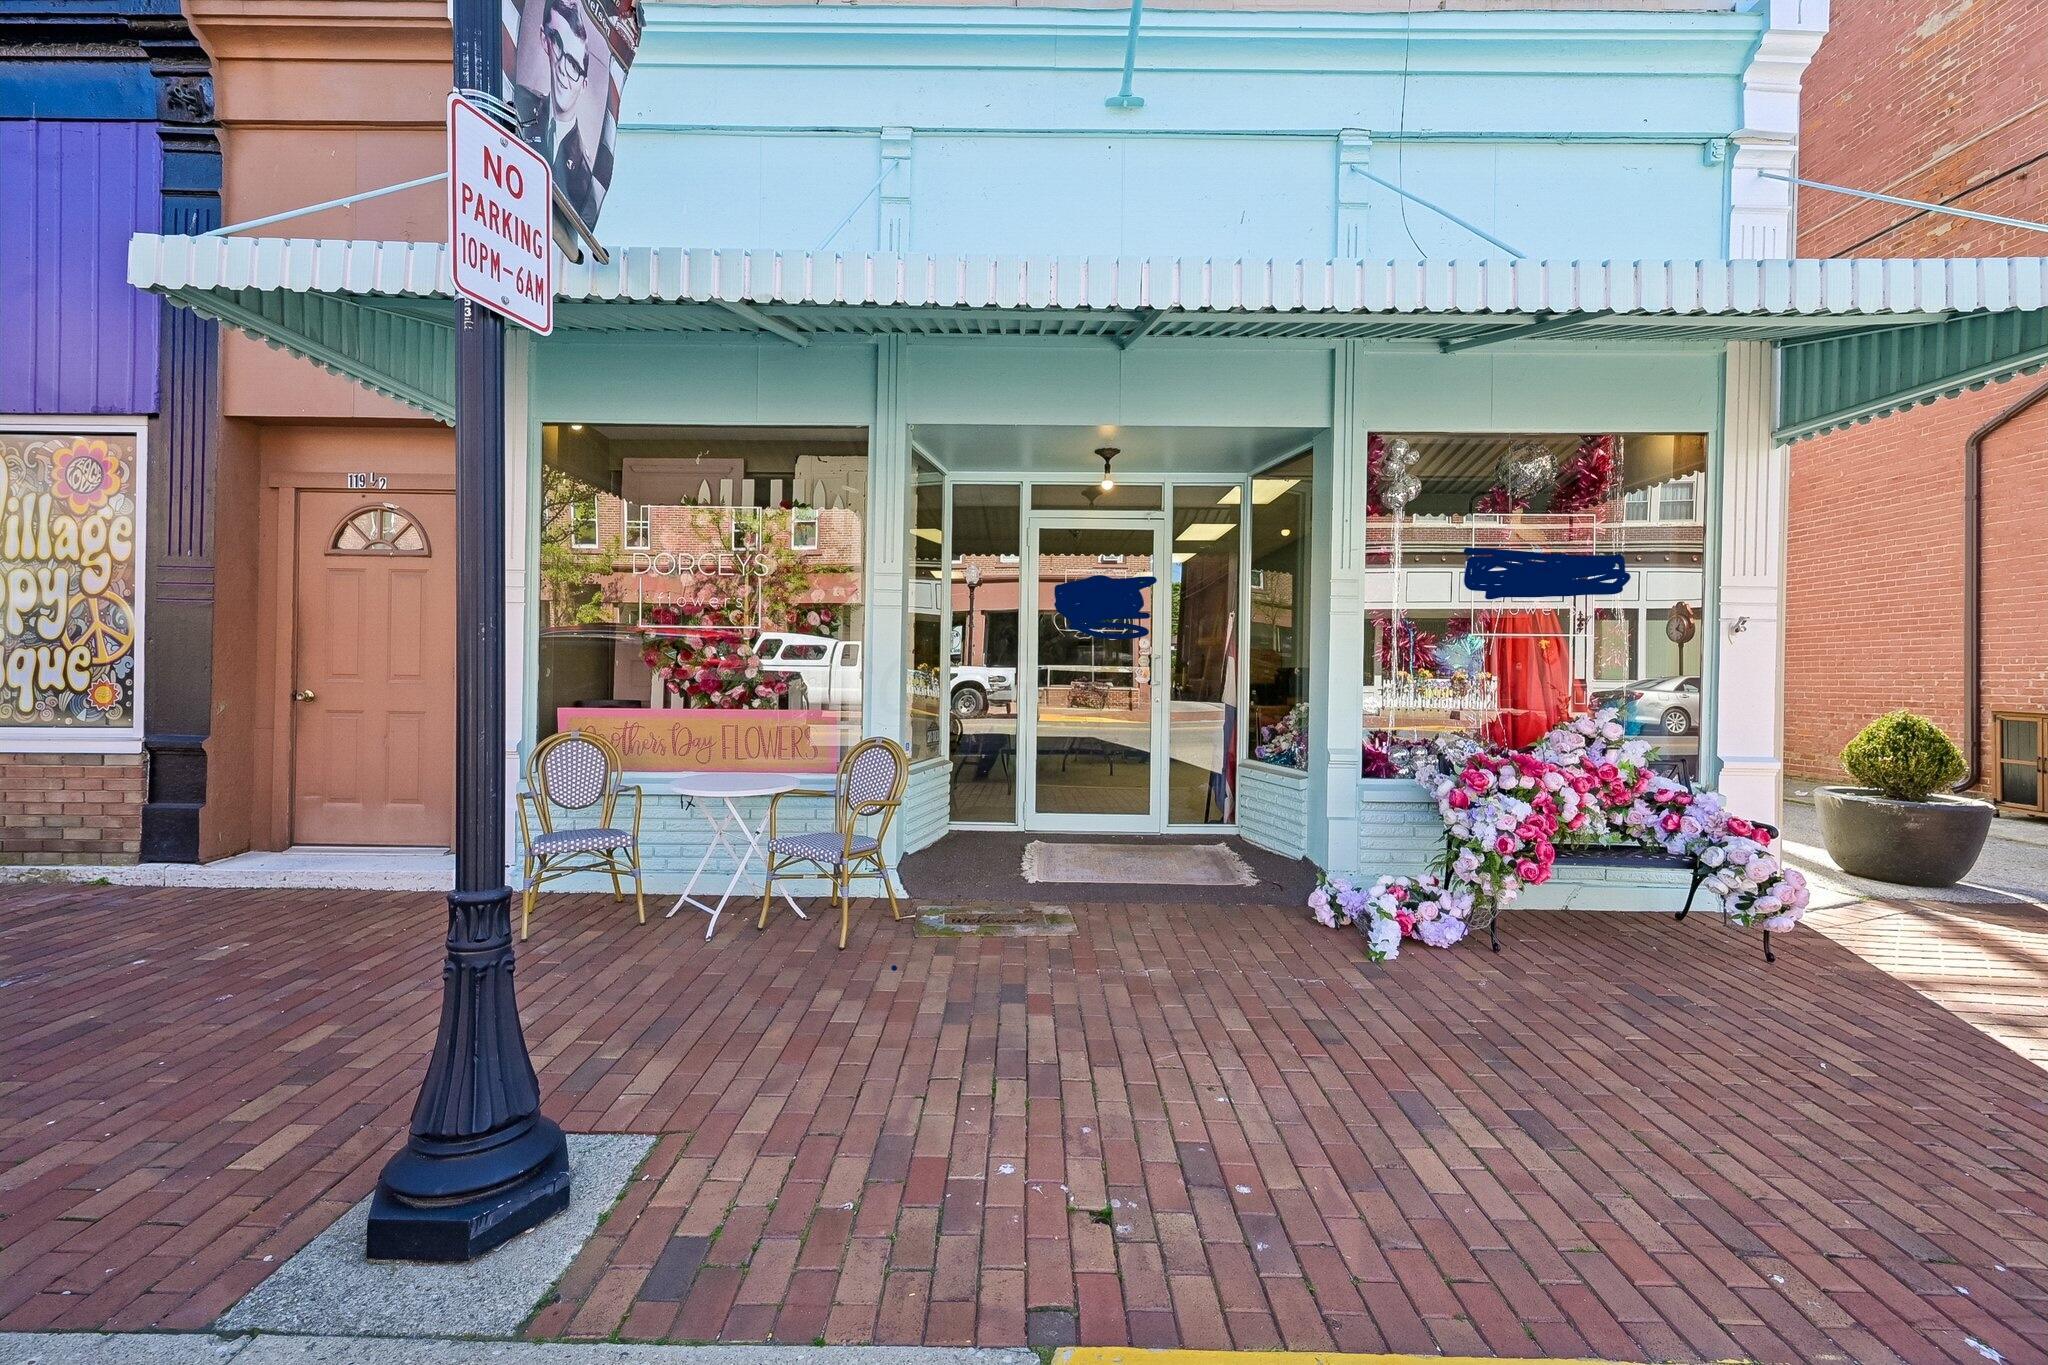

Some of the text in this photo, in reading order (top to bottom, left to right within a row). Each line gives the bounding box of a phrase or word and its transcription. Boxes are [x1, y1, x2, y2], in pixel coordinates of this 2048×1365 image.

[483, 146, 524, 200] NO
[462, 183, 543, 259] PARKING
[348, 473, 366, 488] 119
[0, 453, 133, 595] illage
[633, 552, 769, 577] DORCEYS
[0, 567, 69, 641] py
[657, 591, 744, 608] flowers
[1490, 600, 1577, 616] lowers
[0, 645, 93, 713] que
[585, 721, 818, 764] other's Day FLOWERS
